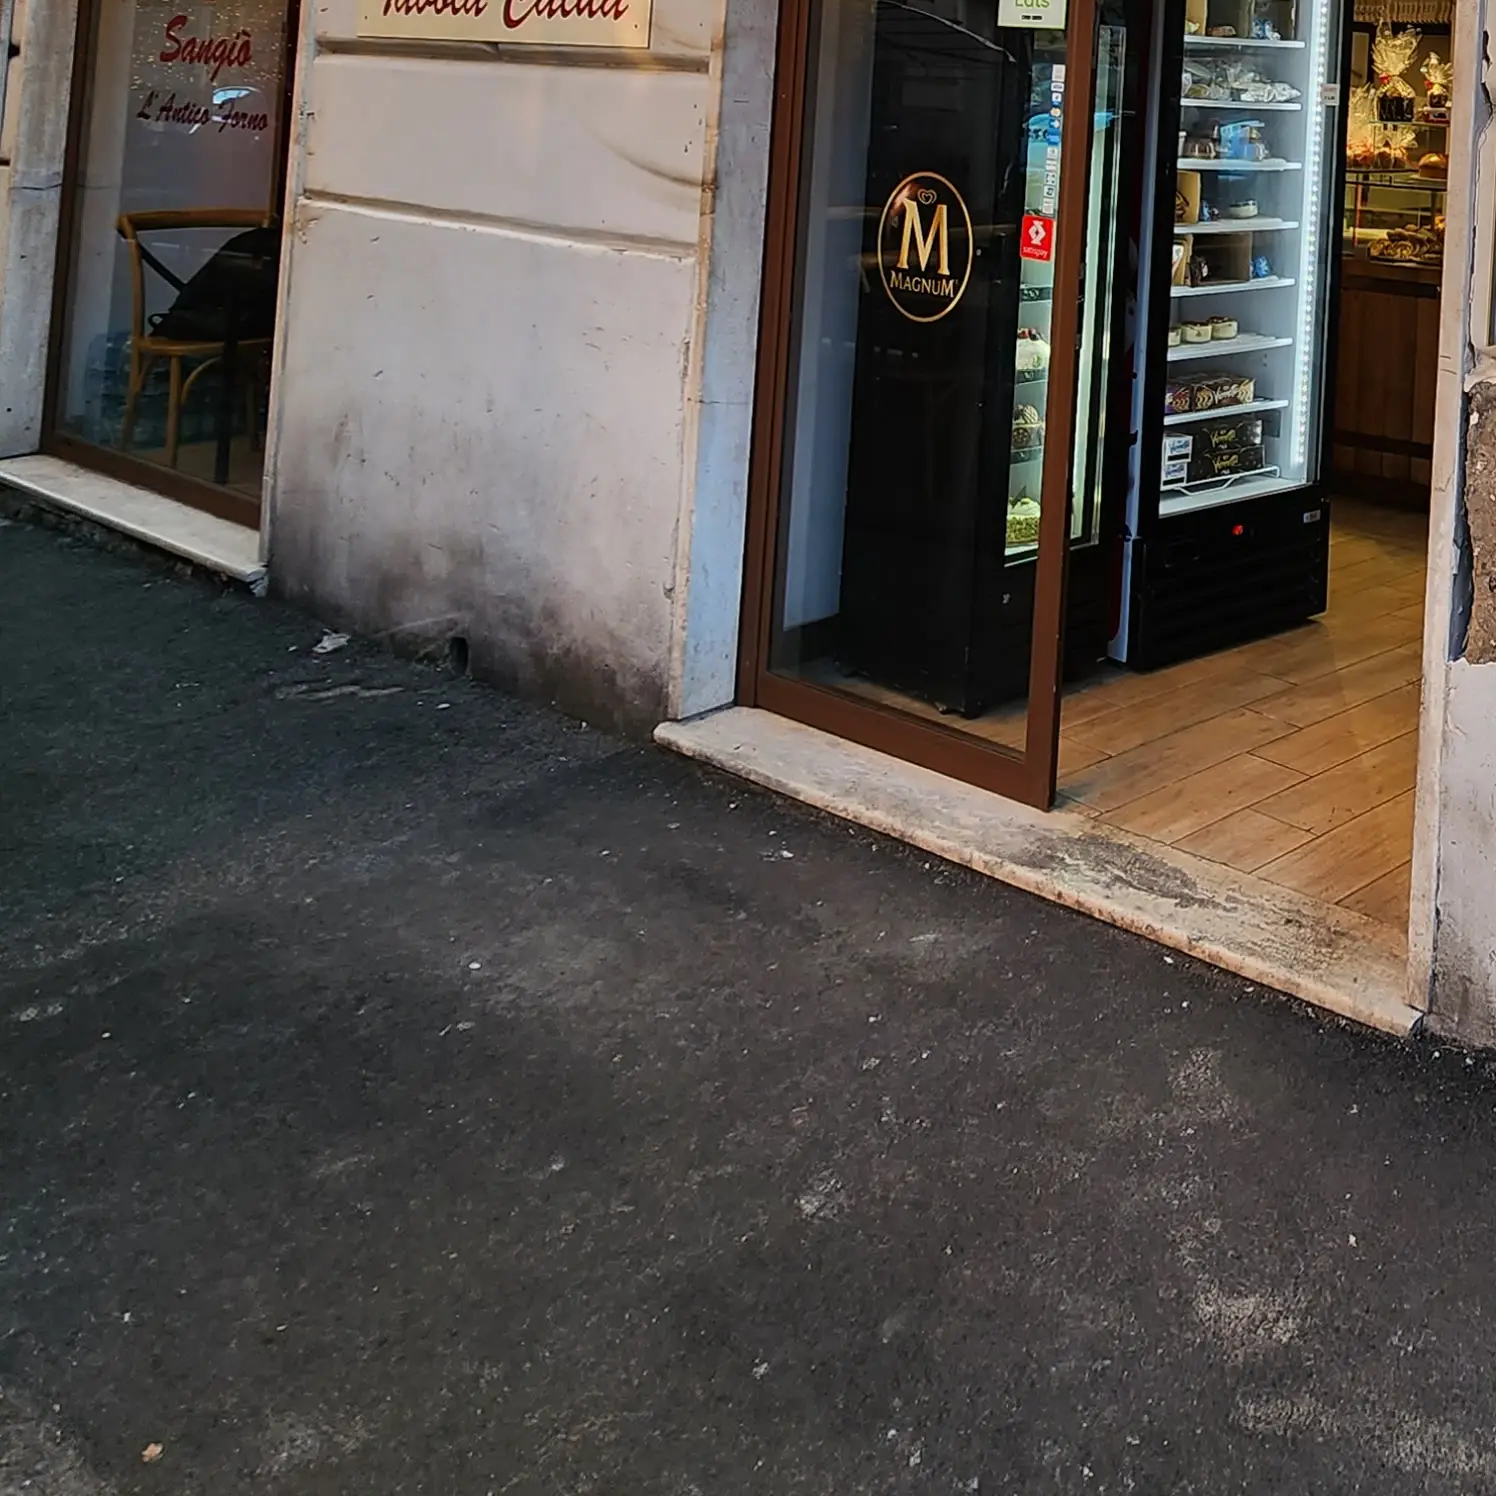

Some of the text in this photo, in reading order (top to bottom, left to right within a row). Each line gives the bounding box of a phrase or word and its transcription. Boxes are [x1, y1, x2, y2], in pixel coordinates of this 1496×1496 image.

[160, 15, 252, 82] Sangiò
[896, 197, 950, 276] M
[890, 270, 955, 298] MAGNUM
